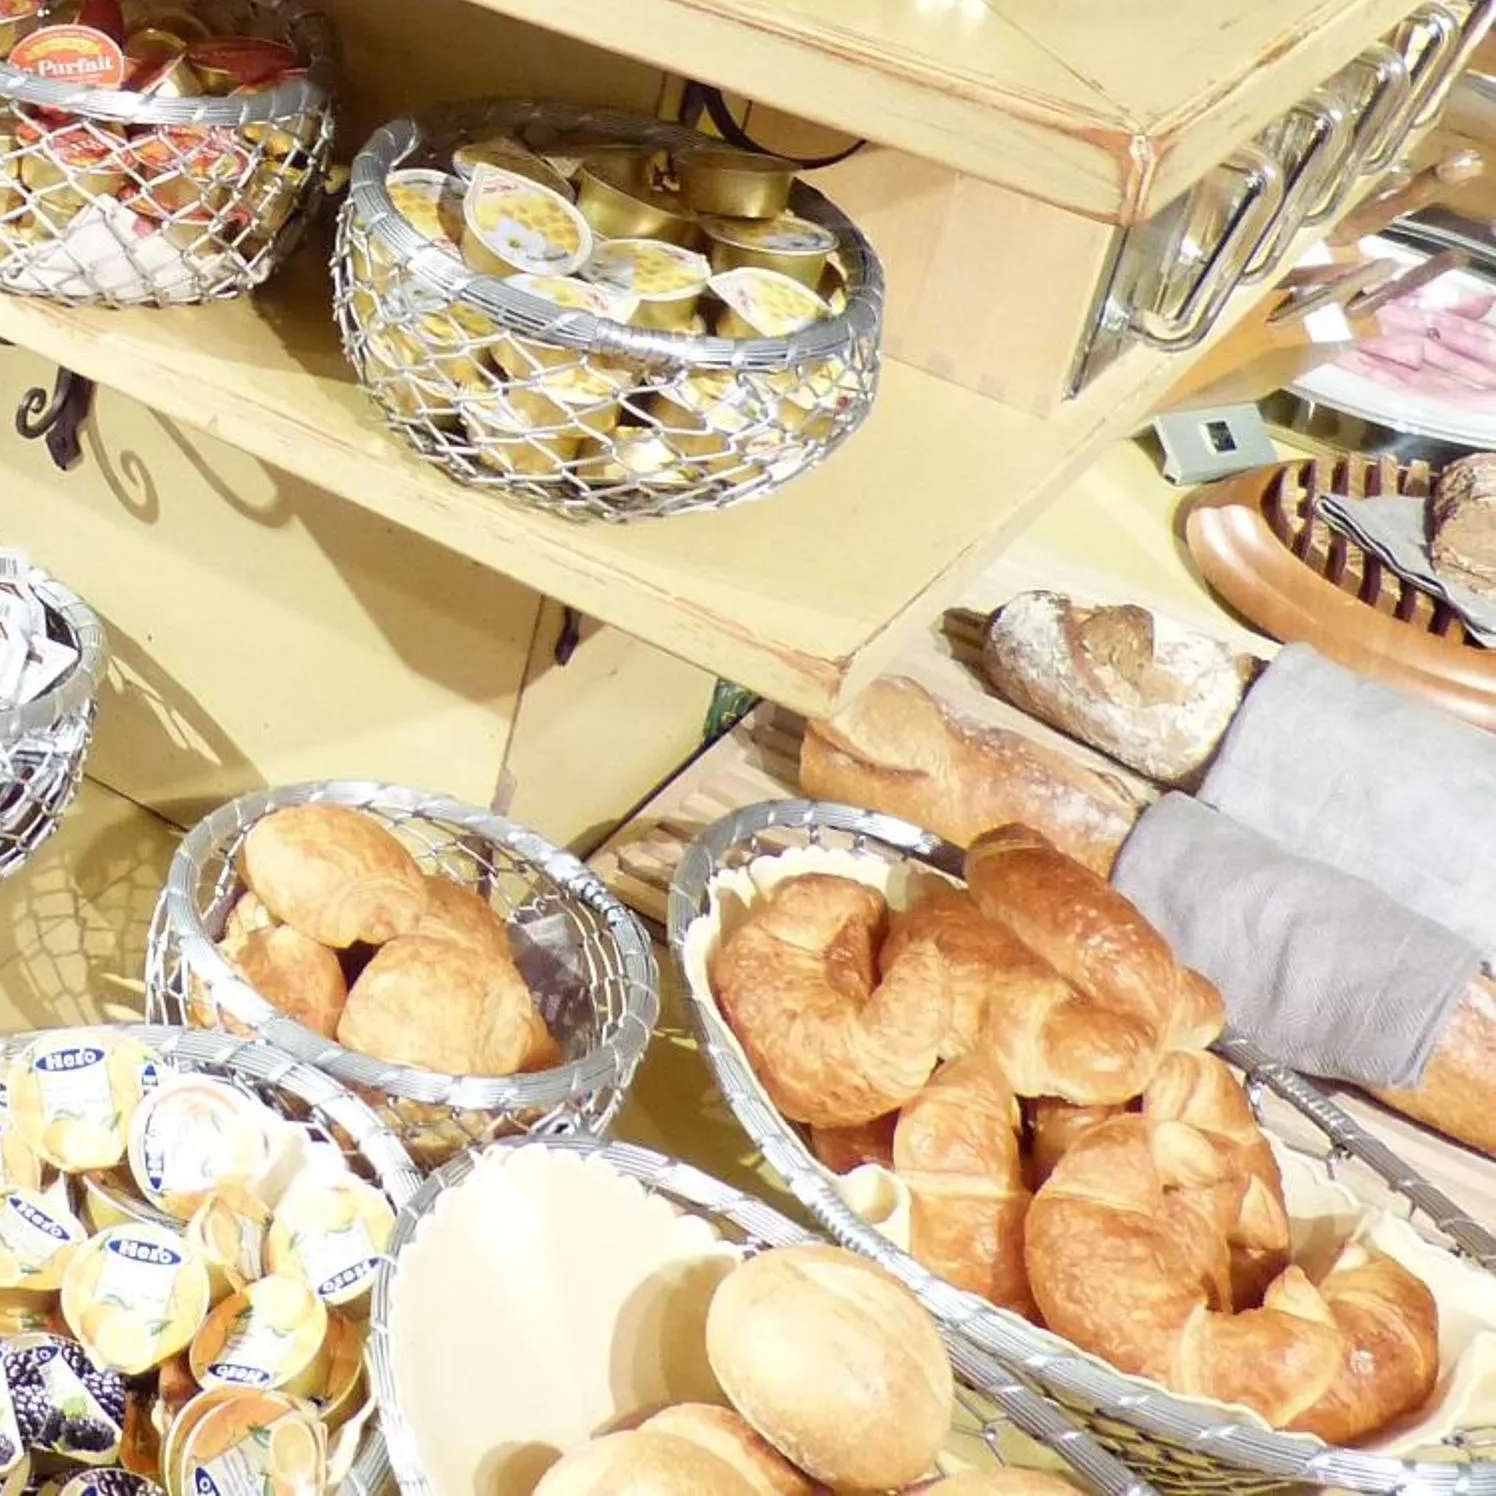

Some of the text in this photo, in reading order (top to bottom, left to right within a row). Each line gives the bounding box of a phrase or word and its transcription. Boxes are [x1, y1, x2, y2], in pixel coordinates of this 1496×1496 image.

[38, 55, 114, 77] Parfait
[45, 1048, 98, 1071] Hero
[118, 1238, 174, 1265] Hero
